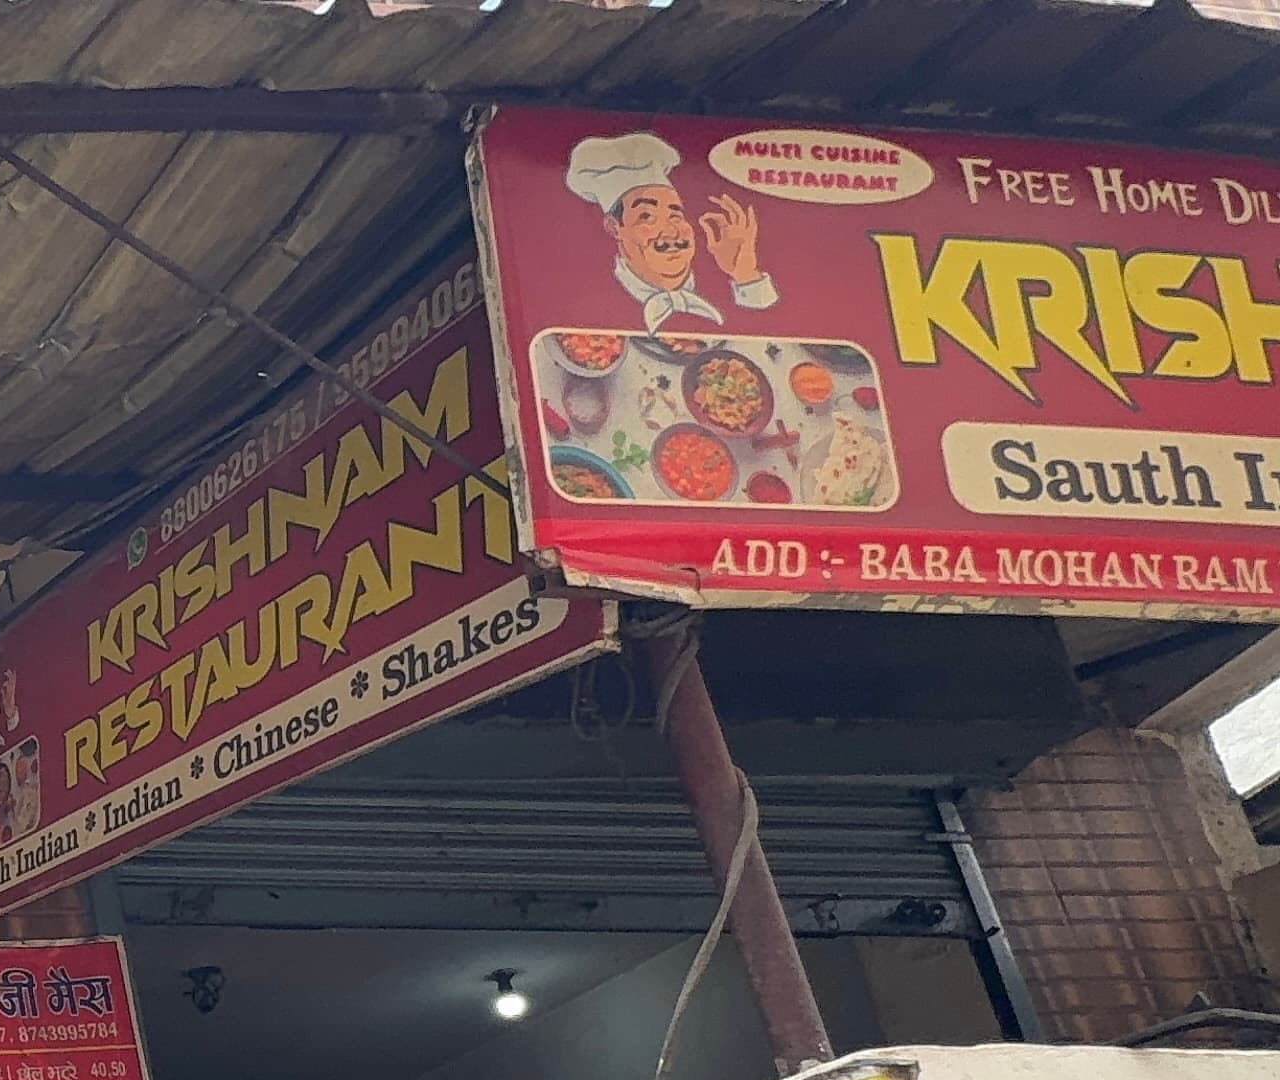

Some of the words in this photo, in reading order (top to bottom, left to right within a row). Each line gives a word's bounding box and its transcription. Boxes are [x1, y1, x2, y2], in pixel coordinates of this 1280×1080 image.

[734, 140, 802, 160] MULTI
[811, 145, 901, 165] CUISINE
[747, 168, 899, 191] RESTAURANT
[957, 157, 1076, 206] FREE
[1086, 166, 1204, 216] HOME
[991, 440, 1221, 508] Sauth
[87, 344, 471, 686] KRISHNAM
[711, 540, 807, 578] ADD
[860, 542, 987, 584] BABA
[996, 548, 1165, 590] MOHAN
[1172, 555, 1274, 596] RAM
[63, 453, 513, 790] RESTAURANT
[16, 826, 80, 879] Indian
[102, 776, 183, 836] Indian
[214, 697, 340, 779] Chinese
[381, 598, 540, 700] Shakes
[42, 966, 115, 1017] मैस
[19, 1022, 119, 1042] 8743995784
